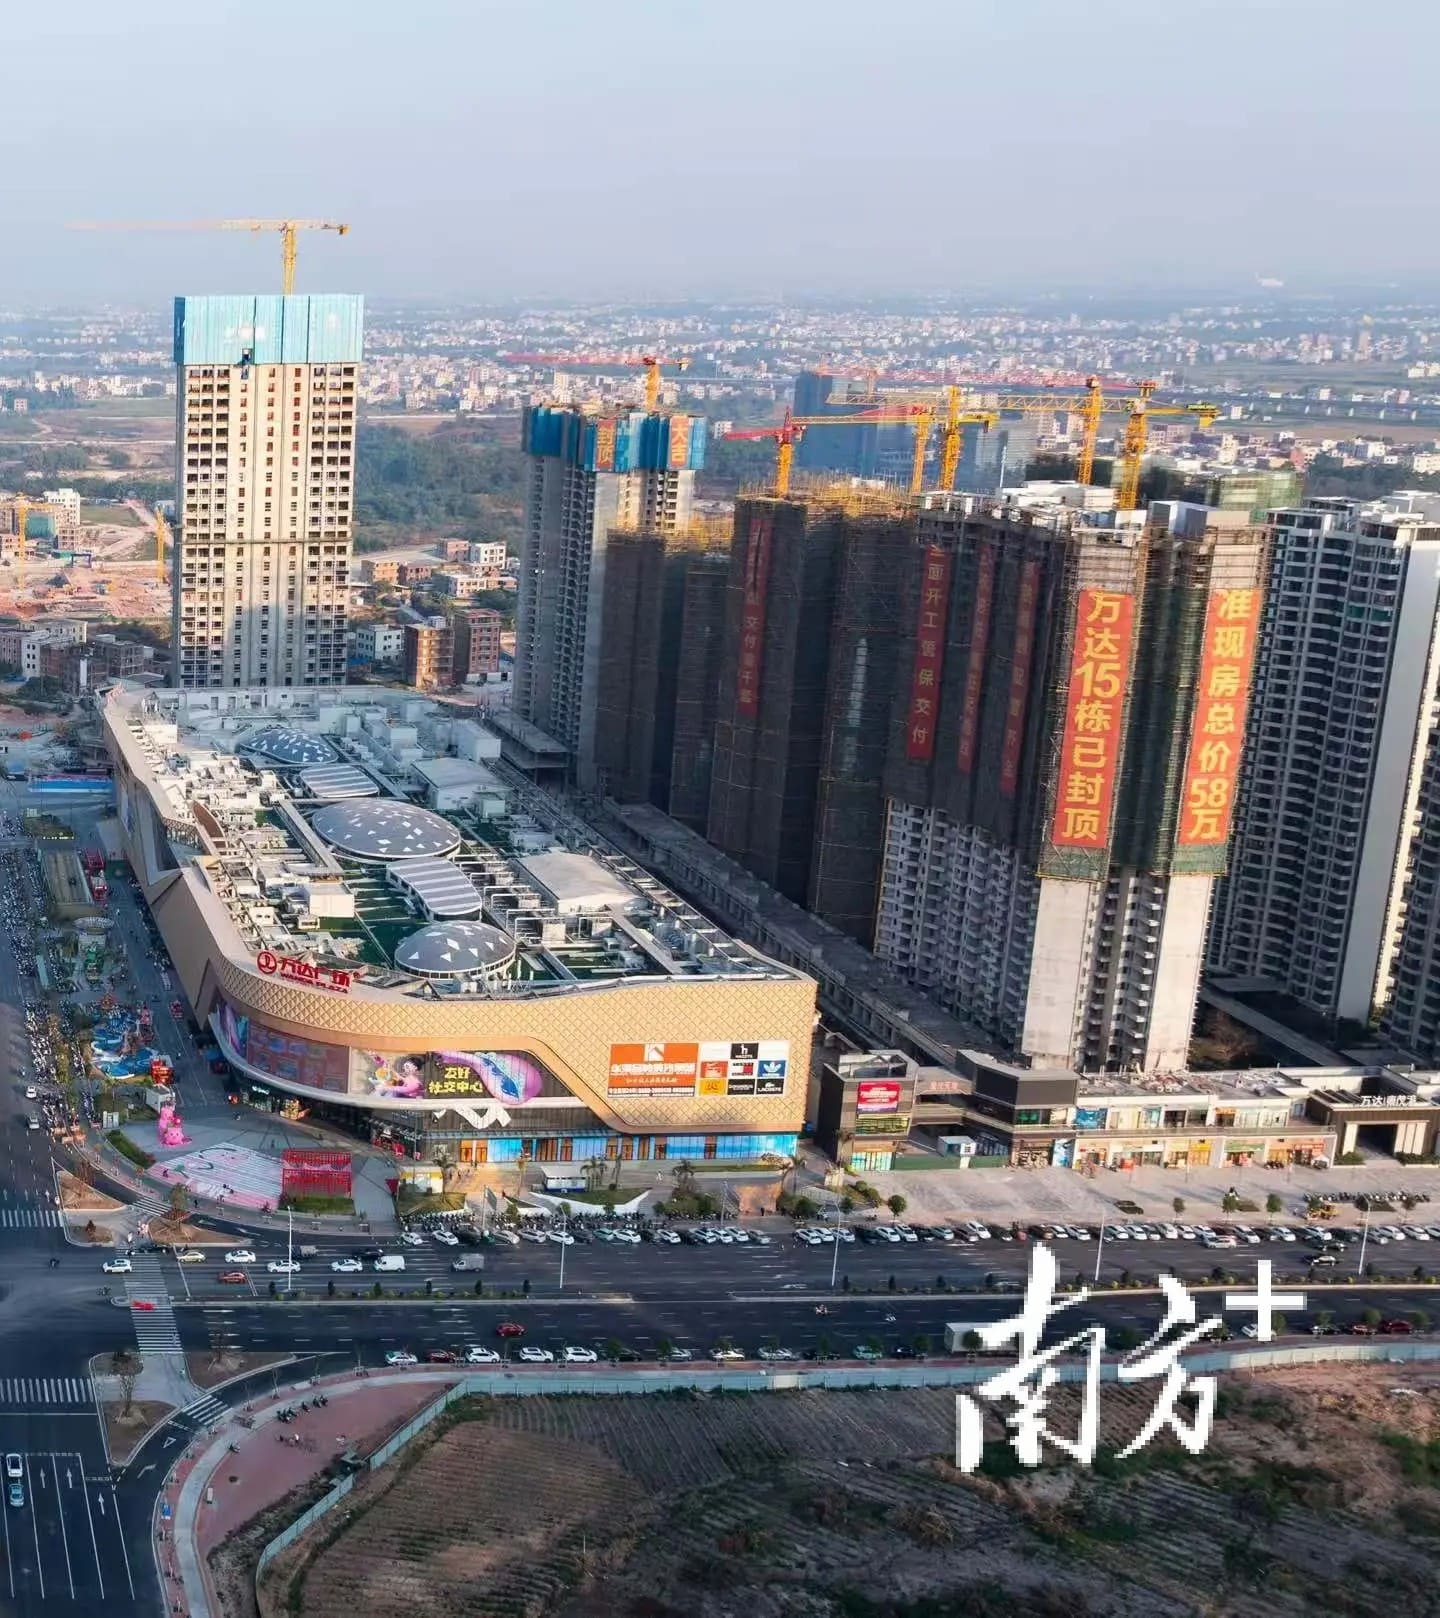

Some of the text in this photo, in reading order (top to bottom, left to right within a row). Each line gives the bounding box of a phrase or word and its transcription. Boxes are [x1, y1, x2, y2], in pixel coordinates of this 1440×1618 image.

[597, 427, 614, 464] 封顶
[671, 421, 688, 462] 大吉
[1062, 591, 1121, 840] 万达15栋已封顶
[1188, 589, 1254, 839] 准现房总价58万
[428, 1081, 483, 1095] 社交中心
[444, 1066, 471, 1080] 友好
